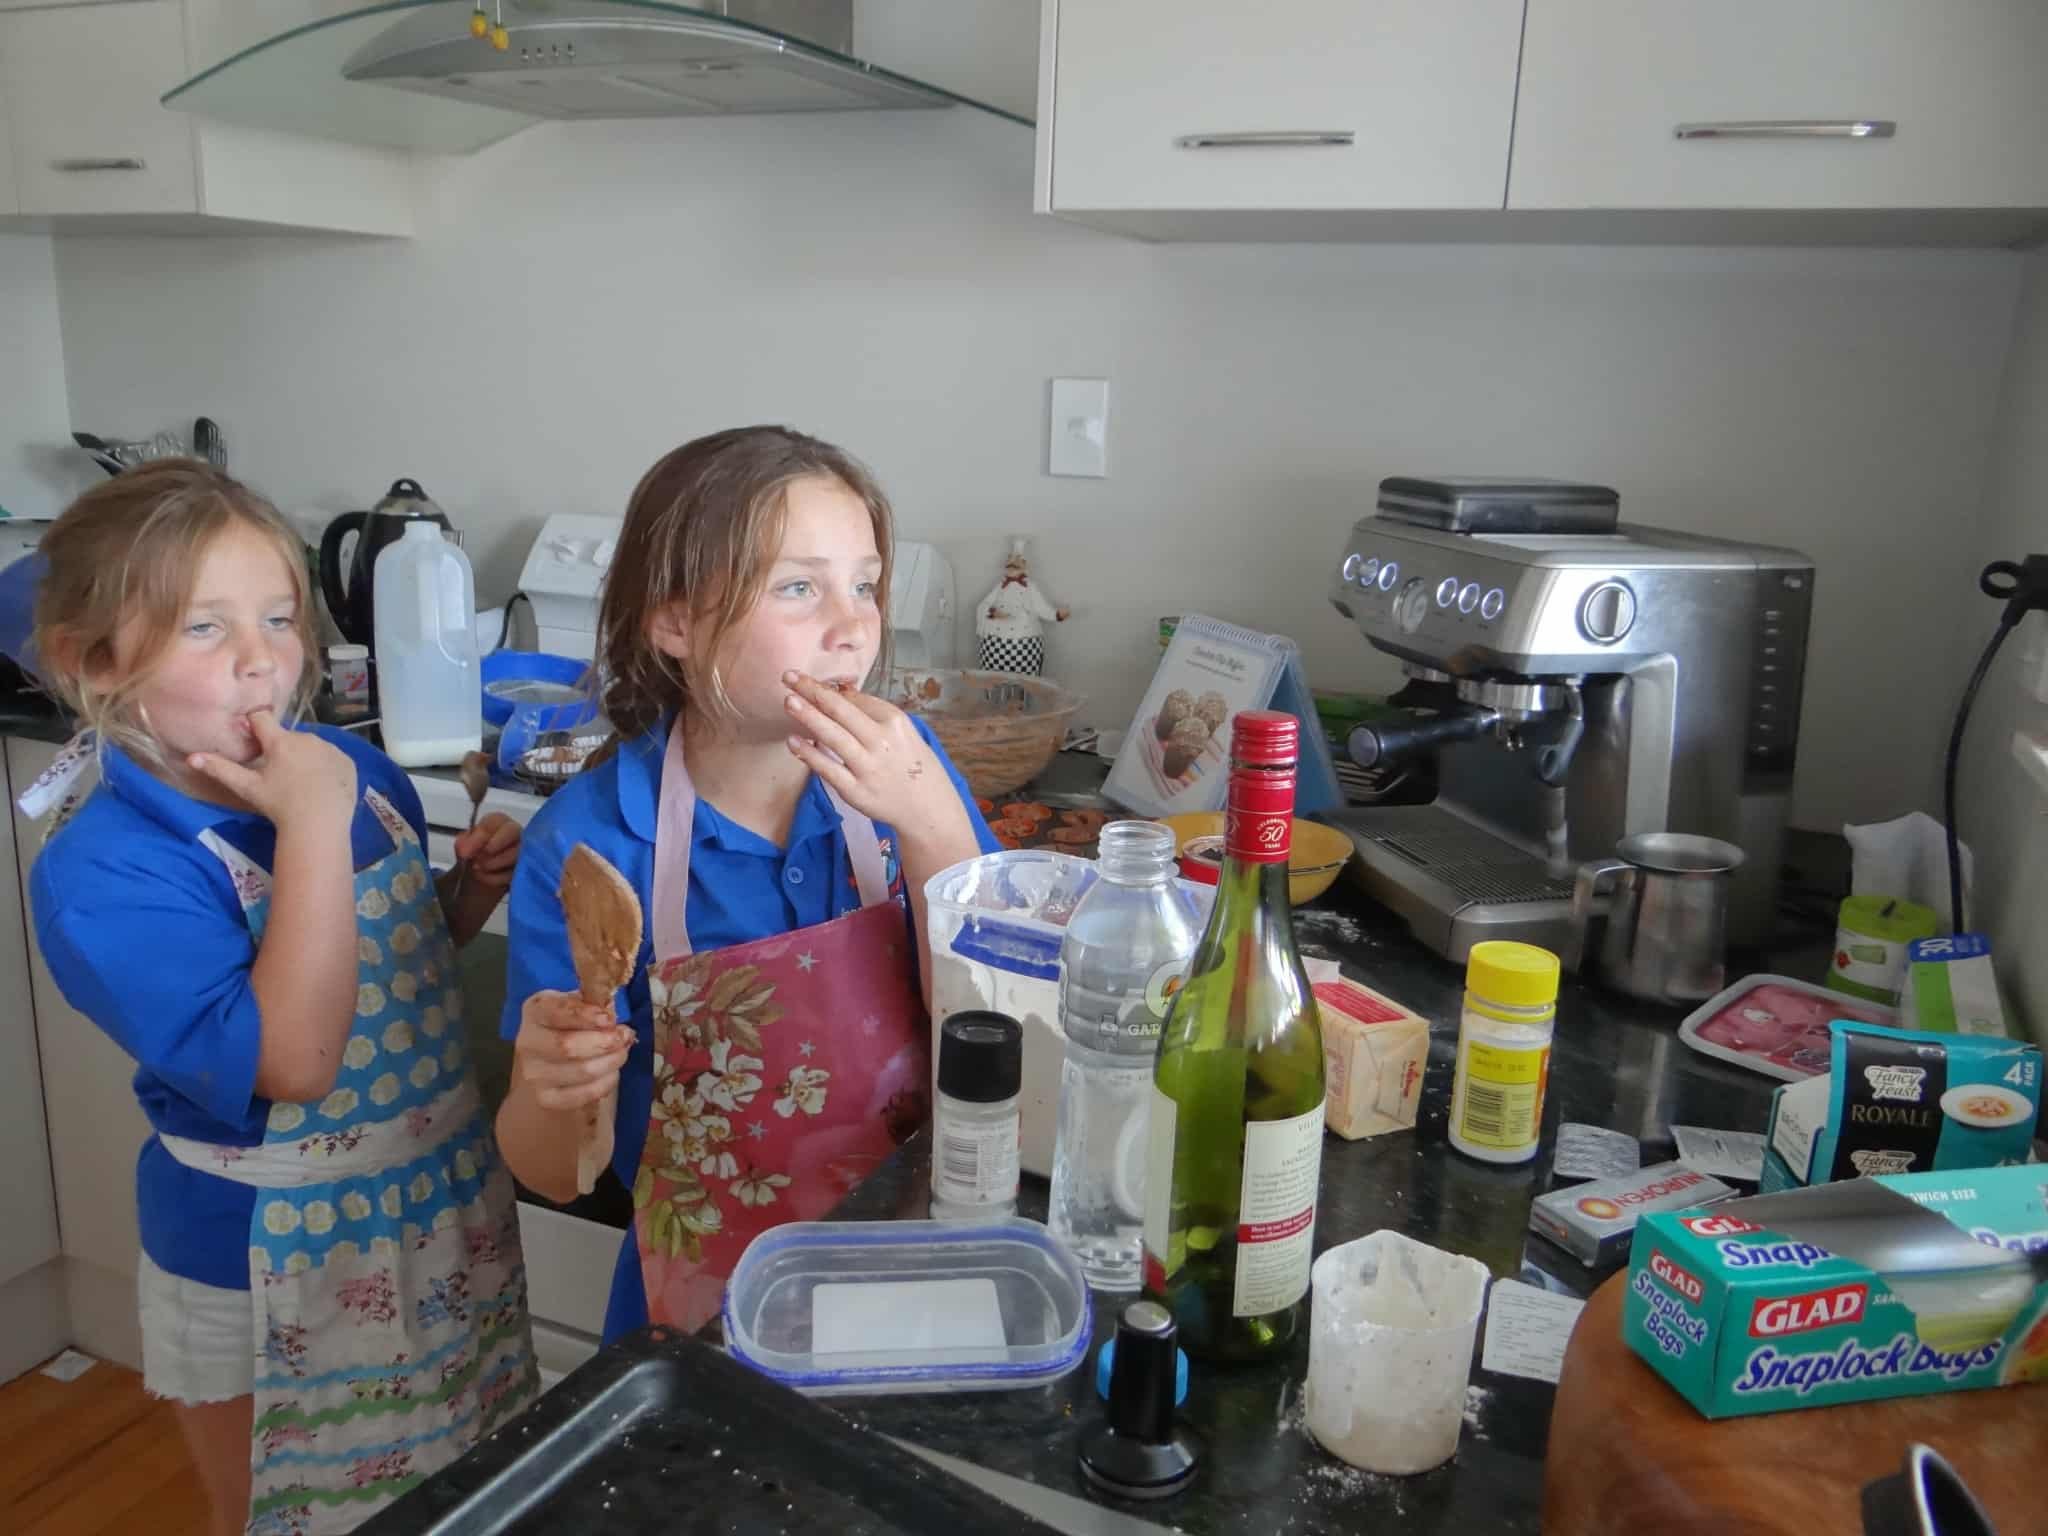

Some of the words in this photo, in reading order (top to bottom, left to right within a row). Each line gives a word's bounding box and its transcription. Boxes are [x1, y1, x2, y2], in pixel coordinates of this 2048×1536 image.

[1259, 825, 1285, 842] 50
[1868, 1068, 1919, 1086] Fancy
[2003, 1060, 2021, 1086] 4
[1615, 1171, 1705, 1208] NUROFEN
[1690, 1214, 1767, 1235] GL
[1651, 1255, 1702, 1297] GLAD
[1634, 1270, 1706, 1343] Snaplock
[1754, 1291, 1862, 1335] GLAD
[1646, 1311, 1684, 1355] Bags
[1736, 1336, 1908, 1393] Snaplock
